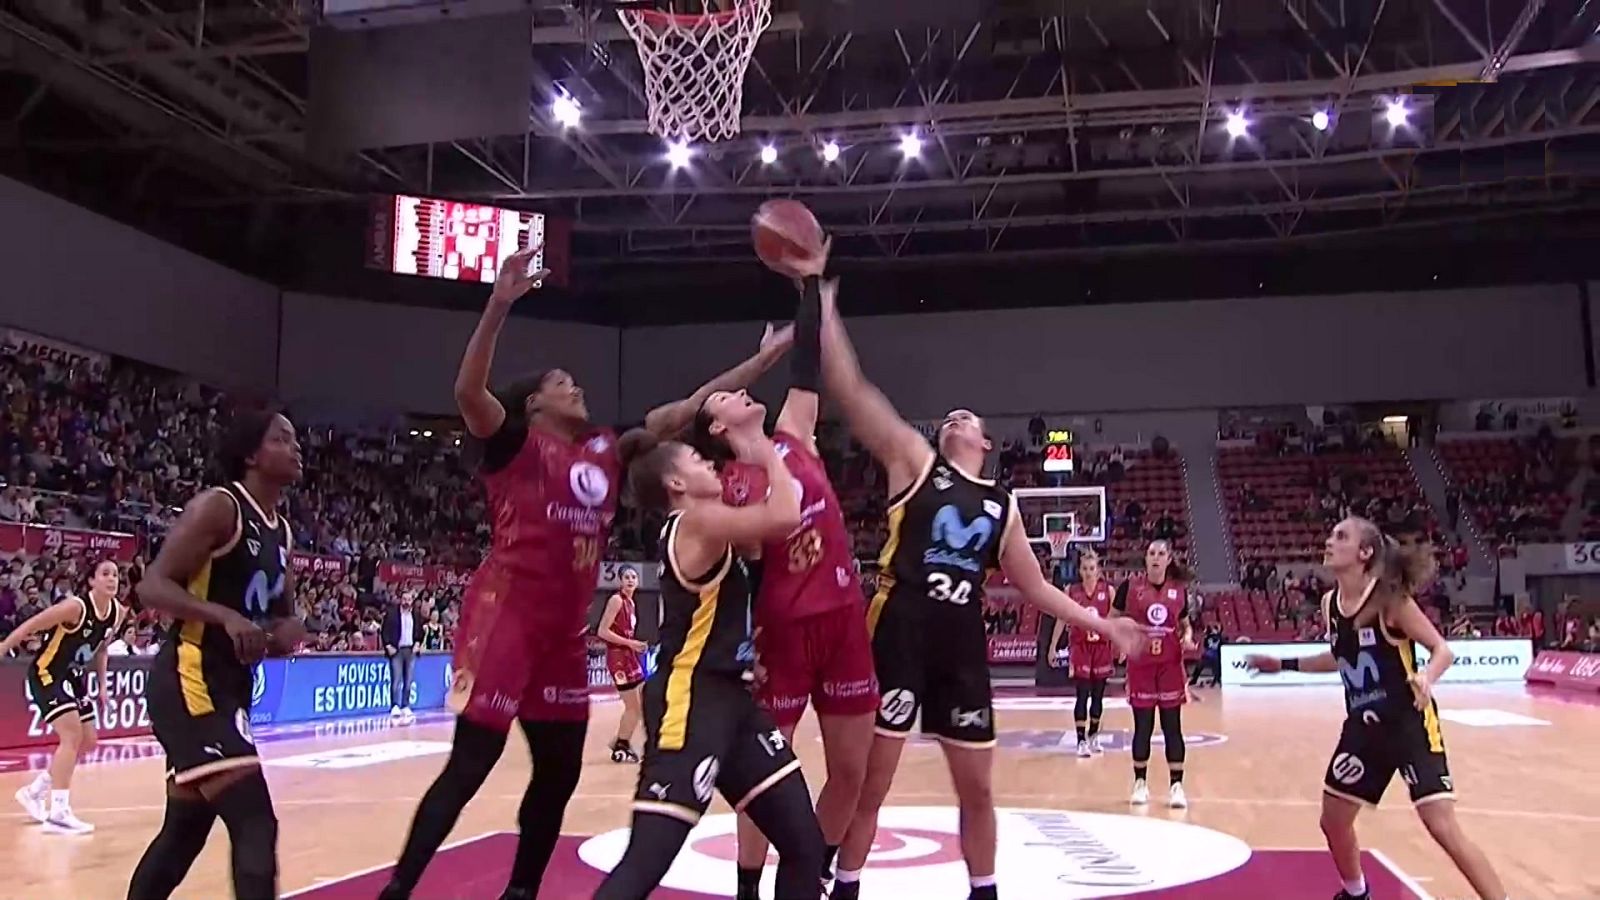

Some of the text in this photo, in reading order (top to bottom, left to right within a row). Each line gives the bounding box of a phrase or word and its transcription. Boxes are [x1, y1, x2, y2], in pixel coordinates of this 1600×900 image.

[1047, 445, 1068, 459] 24
[1151, 639, 1162, 655] 8
[338, 662, 391, 684] MOVISTA
